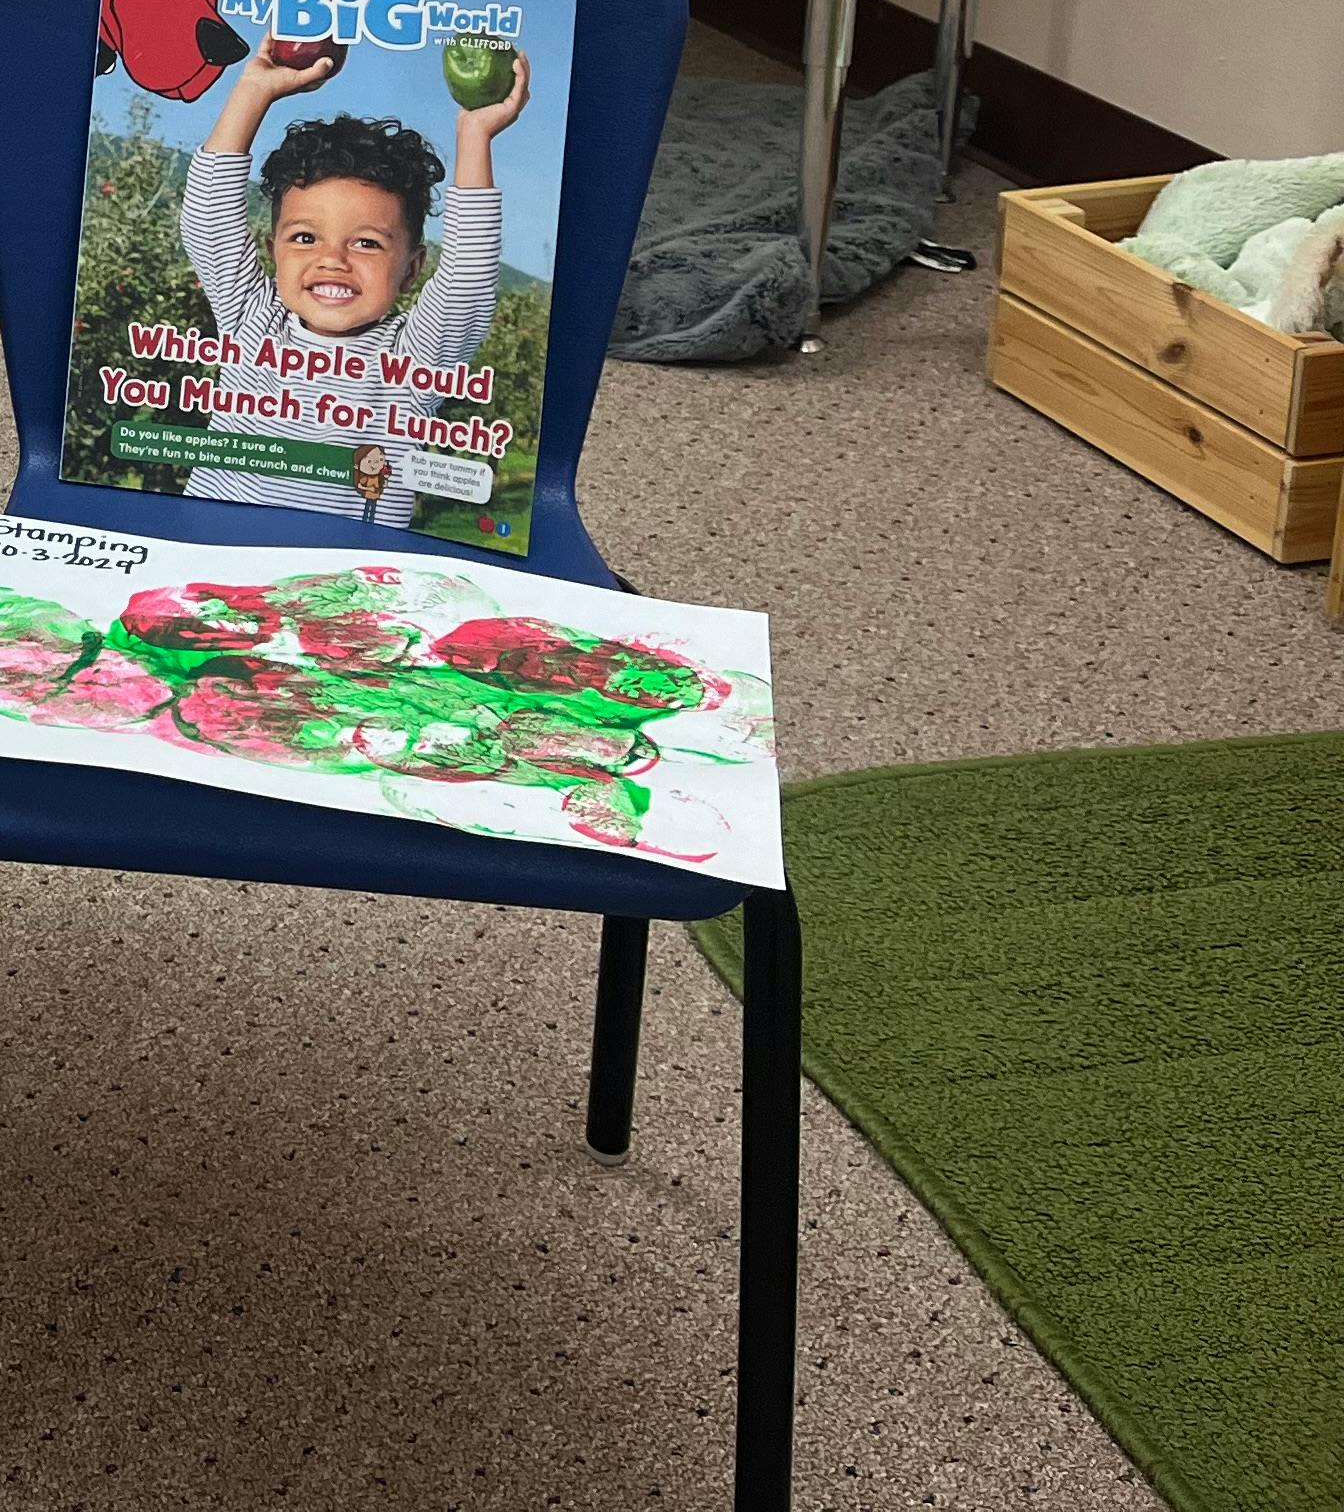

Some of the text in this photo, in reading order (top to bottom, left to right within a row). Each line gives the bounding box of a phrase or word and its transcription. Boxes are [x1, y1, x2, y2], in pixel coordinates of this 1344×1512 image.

[427, 3, 520, 36] World
[434, 36, 511, 51] with CLIFFORD
[128, 322, 494, 404] Which Apple Would
[99, 367, 169, 410] You
[180, 378, 304, 423] Munch
[316, 394, 374, 432] for
[387, 404, 513, 458] Lunch?
[121, 427, 136, 437] Do
[139, 430, 160, 441] you
[163, 432, 182, 443] like
[186, 435, 229, 448] apples?
[232, 439, 238, 449] I
[242, 442, 266, 452] sure
[163, 447, 181, 458] fun
[184, 450, 196, 460] to
[199, 451, 220, 463] bite
[224, 454, 245, 465] and
[249, 458, 288, 471] crunch
[291, 462, 313, 474] and
[316, 466, 350, 480] chew!
[414, 468, 428, 476] you
[430, 459, 447, 468] your
